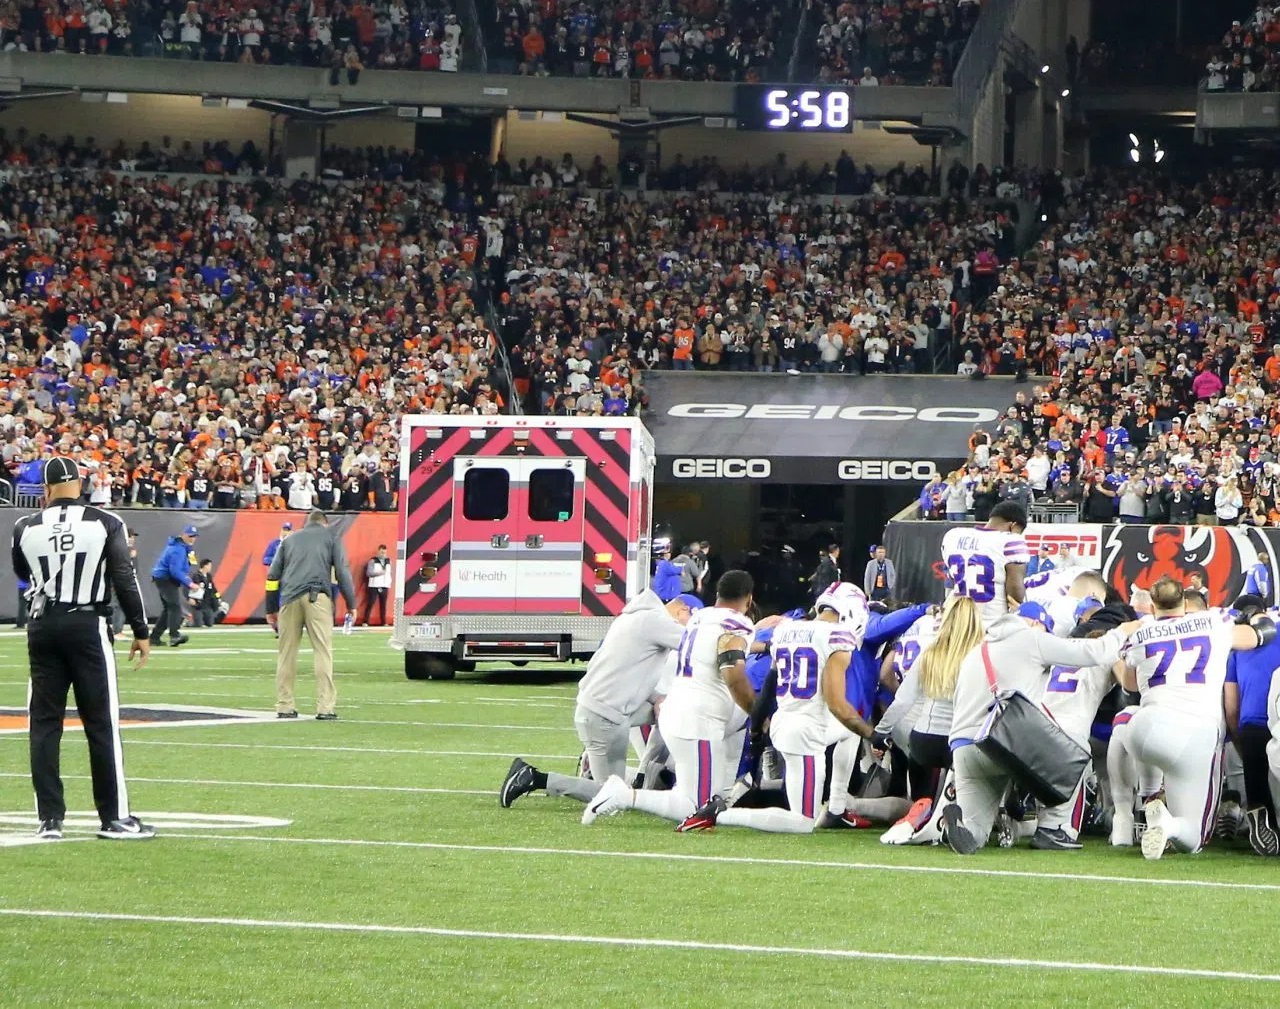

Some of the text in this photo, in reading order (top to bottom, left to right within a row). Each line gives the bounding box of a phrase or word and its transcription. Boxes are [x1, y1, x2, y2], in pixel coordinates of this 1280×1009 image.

[767, 90, 850, 128] 5:58
[666, 402, 1000, 423] GEICO
[1105, 433, 1119, 445] 17
[672, 458, 771, 479] GEICO
[837, 459, 937, 481] GEICO
[317, 478, 333, 492] 85
[52, 522, 72, 534] SJ
[48, 533, 75, 553] 18
[956, 536, 980, 551] NEAL
[473, 570, 507, 582] Health
[776, 628, 815, 645] JACKSON
[1145, 635, 1212, 688] 77
